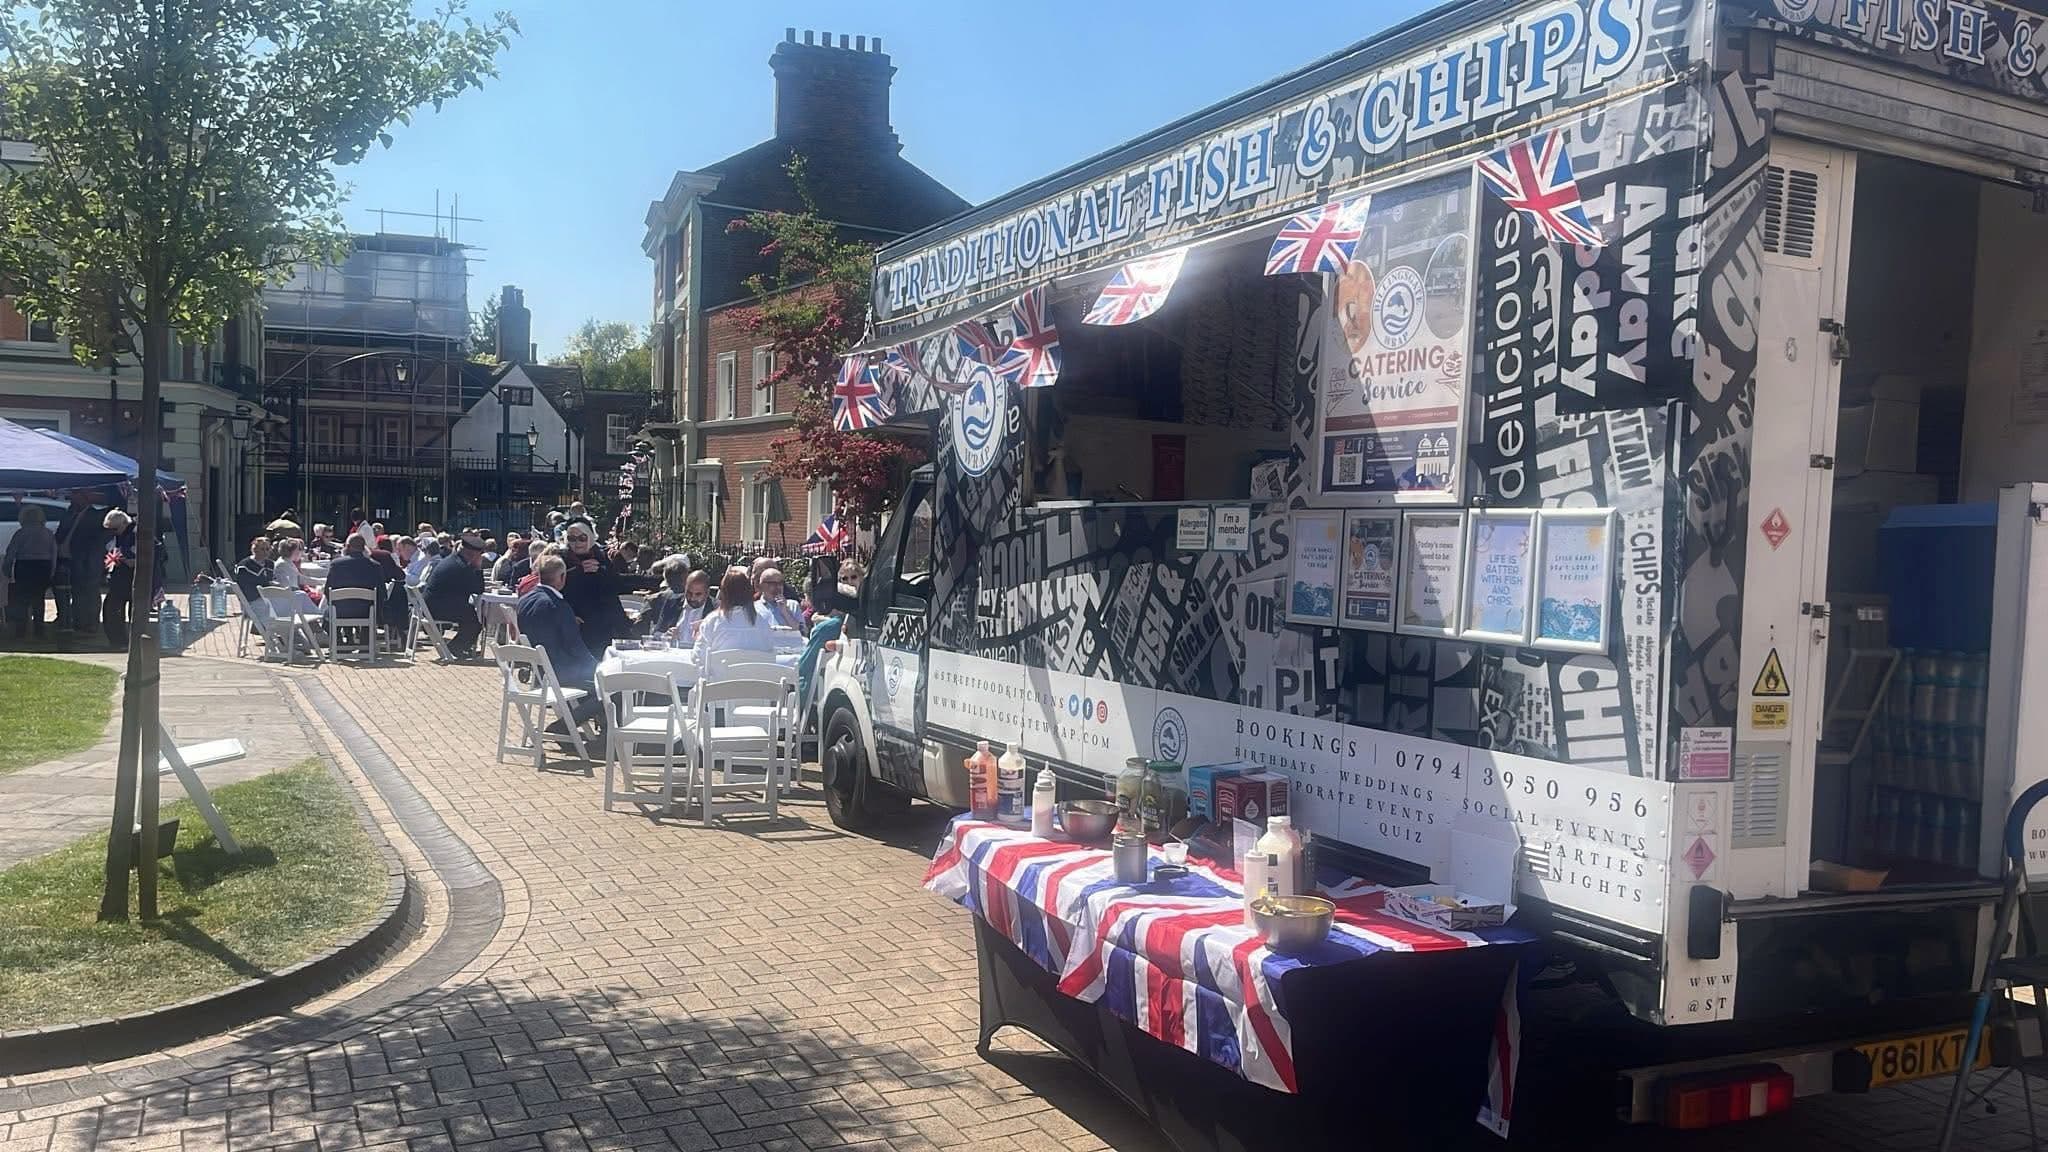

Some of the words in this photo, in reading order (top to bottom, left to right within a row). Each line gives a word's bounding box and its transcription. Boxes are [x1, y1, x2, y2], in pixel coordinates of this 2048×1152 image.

[1842, 0, 1989, 65] FISH
[2008, 20, 2038, 77] &
[889, 183, 1133, 311] TRADITIONAL
[1145, 117, 1283, 228] FISH
[1296, 97, 1336, 178] &
[1356, 0, 1643, 155] CHIPS
[1607, 185, 1668, 384] Away
[1349, 345, 1446, 379] CATERING
[1489, 211, 1525, 499] delicious
[1362, 377, 1427, 405] Service
[1218, 525, 1246, 534] member
[1481, 575, 1501, 585] WITH
[1504, 576, 1523, 585] FISH
[1486, 565, 1519, 575] BATTER
[1489, 555, 1505, 564] LIFE
[1507, 555, 1517, 565] IS
[1630, 532, 1661, 596] CHIPS
[1492, 586, 1510, 595] AND
[1133, 592, 1174, 689] FISH
[1755, 704, 1785, 713] DANGER
[1236, 719, 1357, 757] BOOKINGS
[1396, 750, 1463, 780] 0794
[1483, 768, 1559, 800] 3950
[1585, 787, 1647, 818] 956
[1235, 747, 1317, 774] BIRTHDAYS
[1339, 771, 1434, 802] WEDDINGS
[1463, 798, 1539, 826] SOCIAL
[1555, 818, 1646, 851] EVENTS
[1290, 781, 1355, 806] PORATE
[1367, 800, 1435, 825] EVENTS
[1379, 823, 1423, 843] QUIZ
[1553, 868, 1642, 902] NIGHTS
[1543, 841, 1643, 878] PARTIES
[1931, 1034, 1979, 1071] KT
